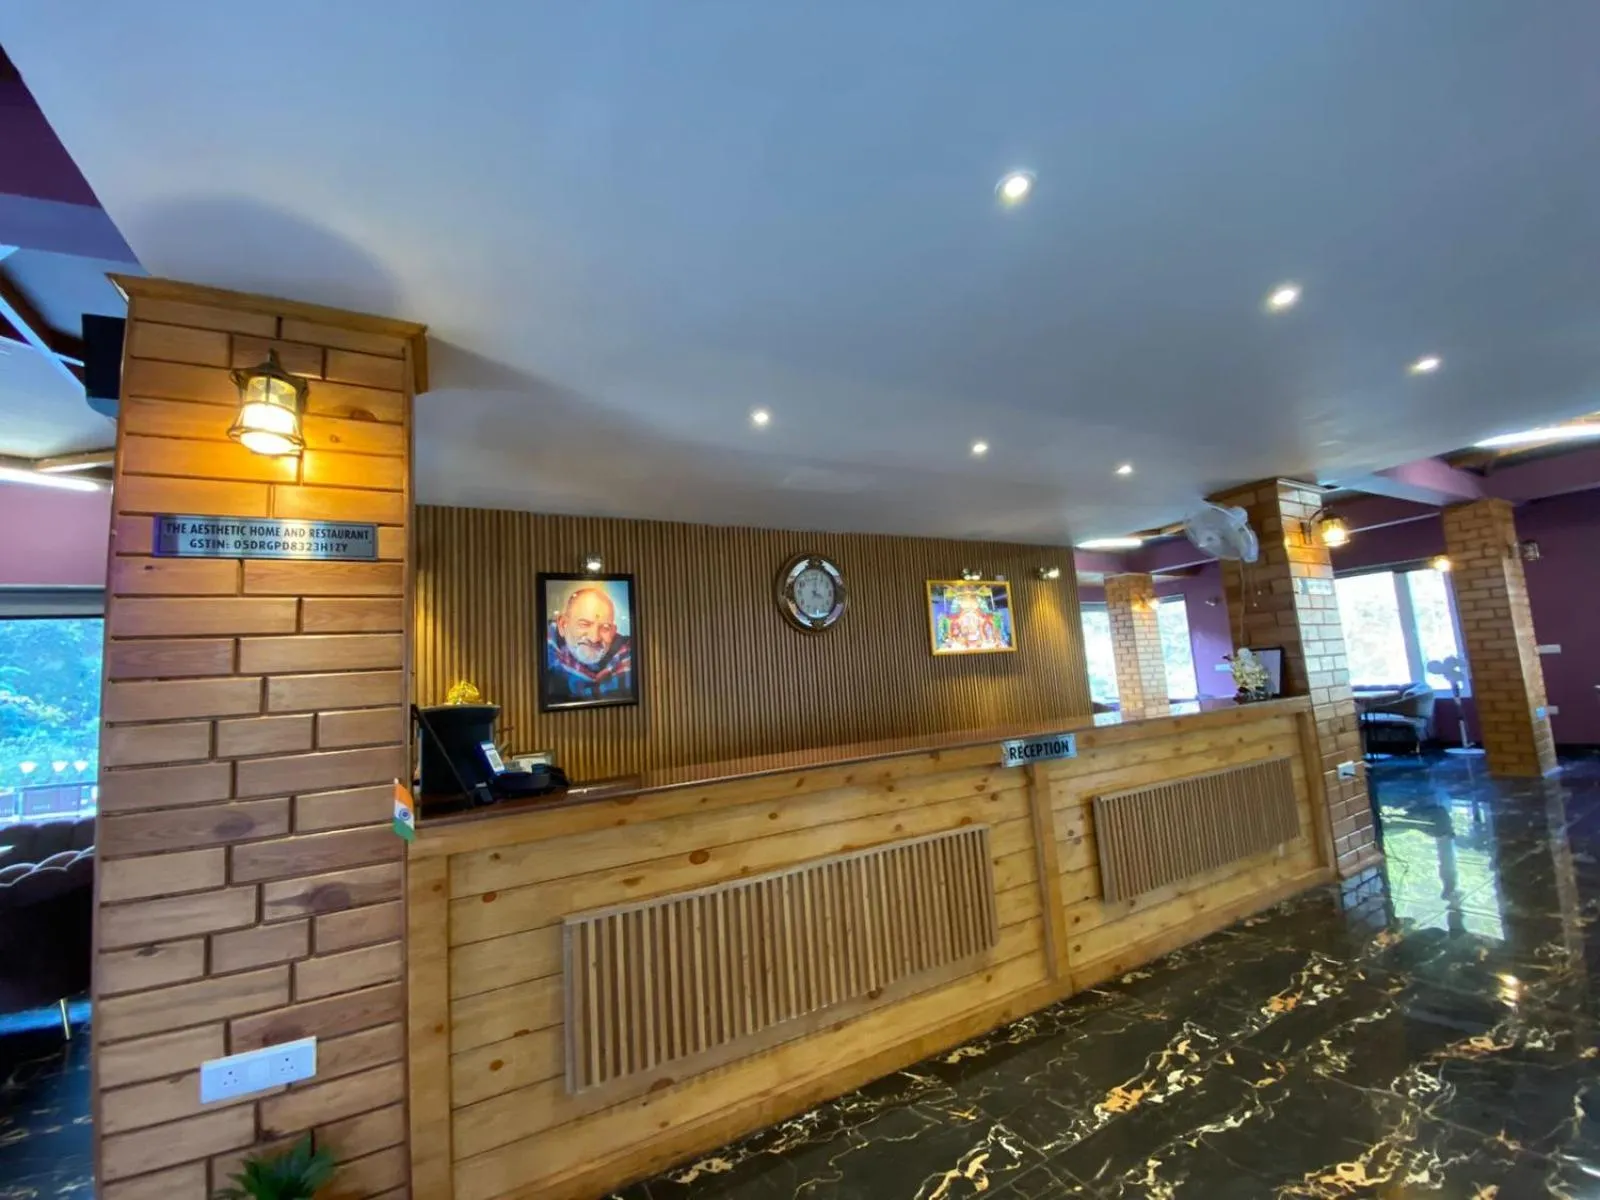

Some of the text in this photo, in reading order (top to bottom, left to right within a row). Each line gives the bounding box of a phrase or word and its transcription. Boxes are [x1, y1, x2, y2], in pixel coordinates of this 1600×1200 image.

[166, 522, 370, 540] THE AESTHETIC HOME AND RESTAURANT
[189, 538, 230, 549] GSTIN:
[1009, 740, 1069, 760] RECEPTION
